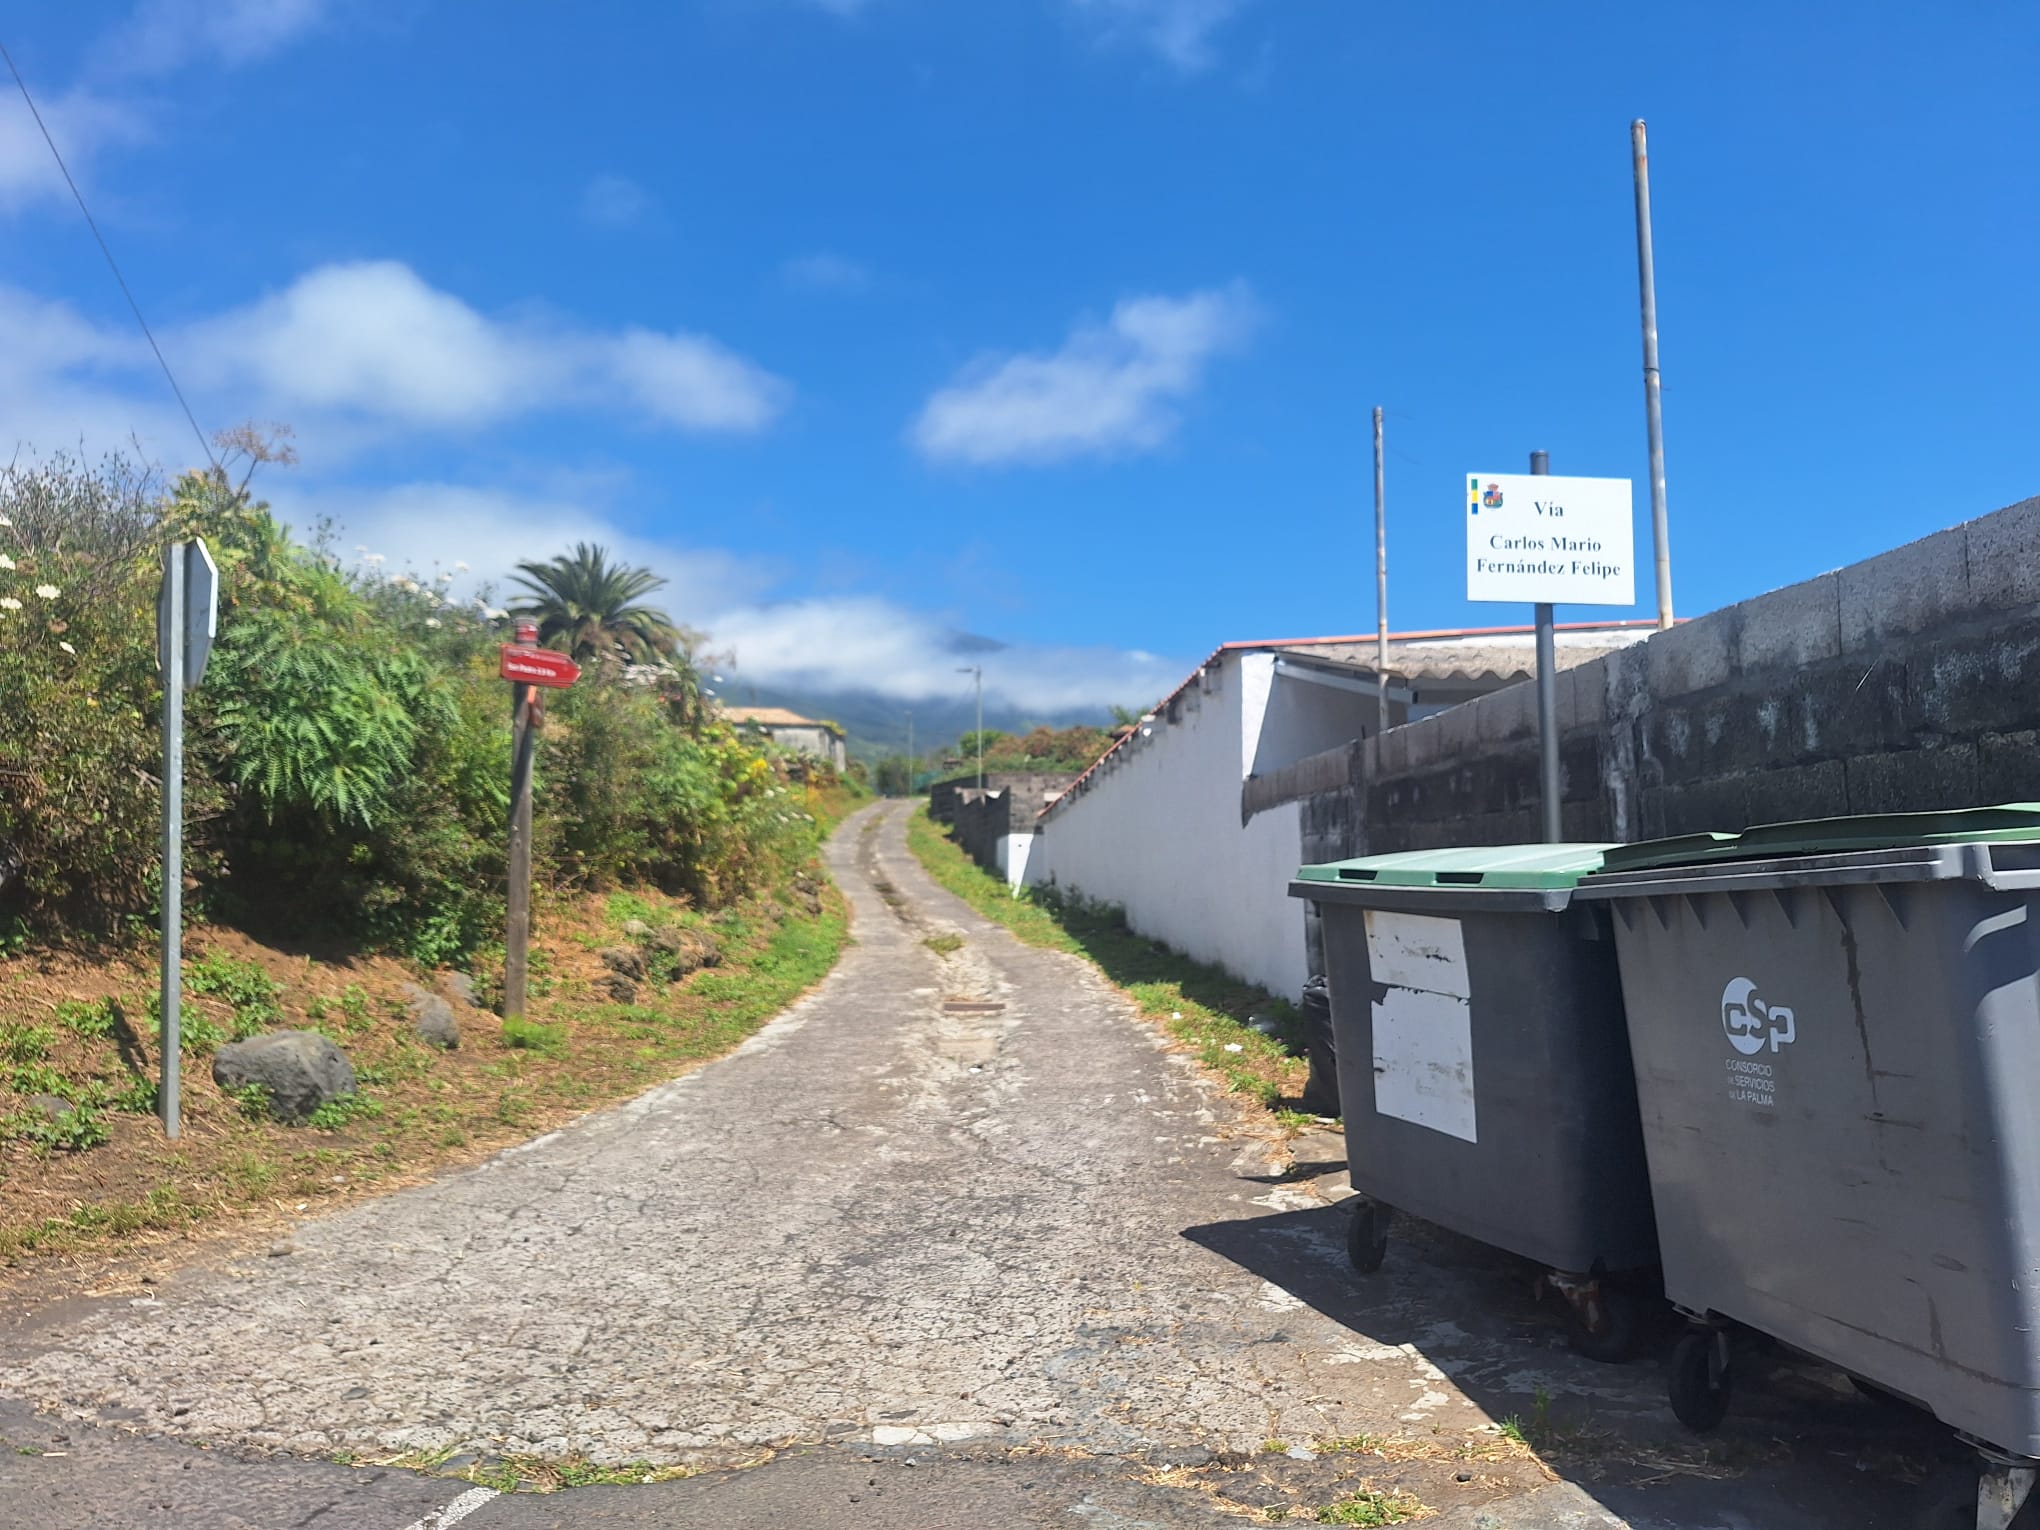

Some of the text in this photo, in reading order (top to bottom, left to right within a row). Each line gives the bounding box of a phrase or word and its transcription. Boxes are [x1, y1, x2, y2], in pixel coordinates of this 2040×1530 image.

[1490, 535, 1602, 553] Carlos Mario
[1477, 558, 1621, 580] Fernández Felipe
[1725, 1058, 1772, 1077] CONSORCIO
[1735, 1074, 1775, 1092] SERVICIOS
[1747, 1090, 1774, 1107] PALMA
